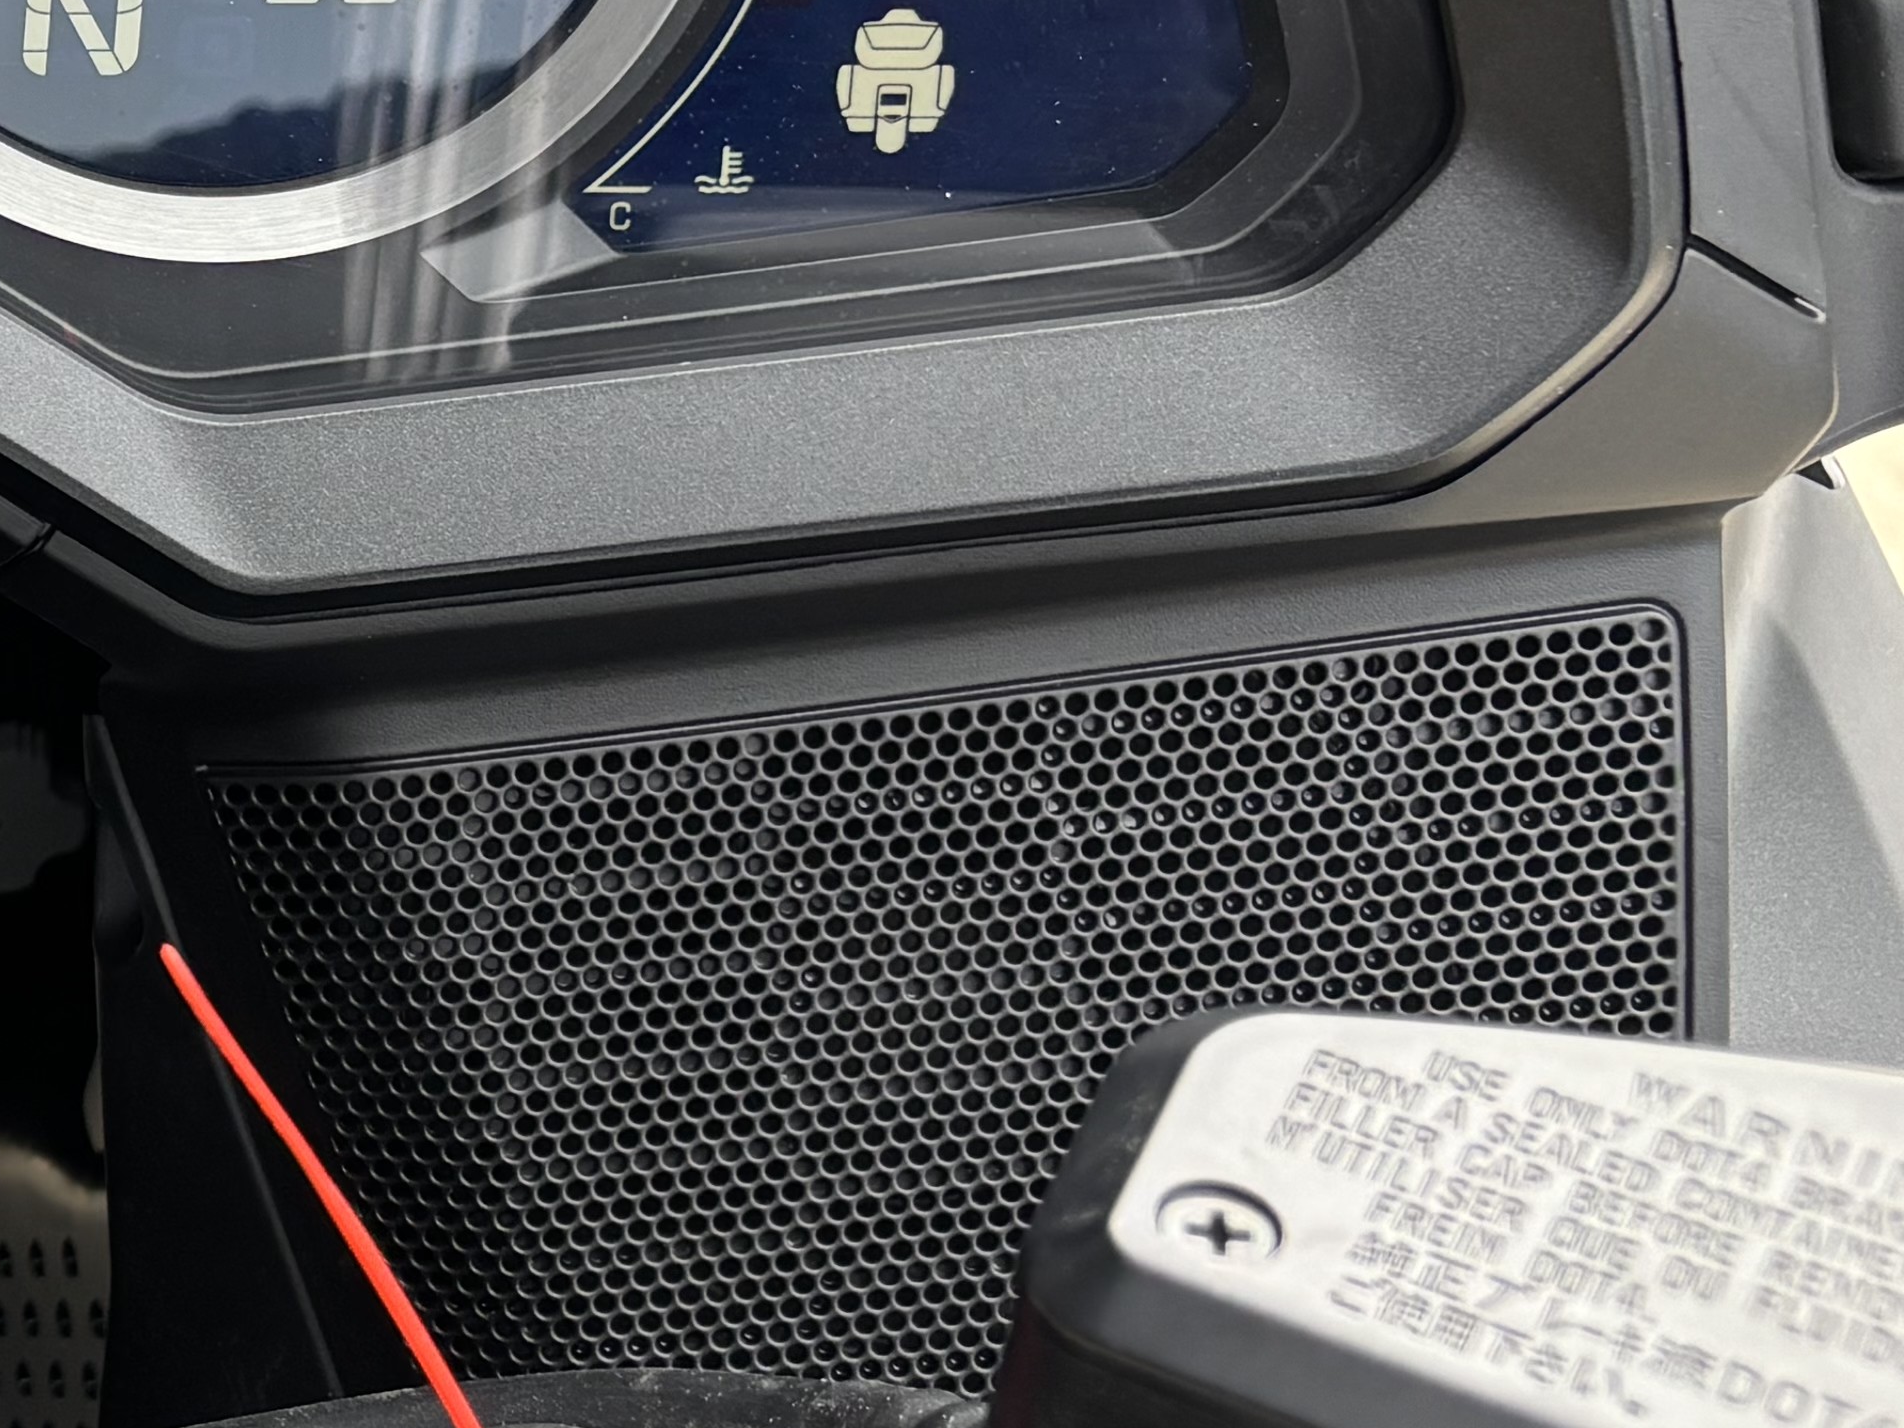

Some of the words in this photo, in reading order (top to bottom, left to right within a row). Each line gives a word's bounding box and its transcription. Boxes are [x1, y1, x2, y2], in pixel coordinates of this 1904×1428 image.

[610, 202, 631, 230] C
[1423, 1049, 1510, 1102] USE
[1284, 1082, 1441, 1161] FILLER
[1302, 1049, 1427, 1112] FROM
[1431, 1095, 1469, 1130] A
[1483, 1111, 1662, 1193] SEALED
[1670, 1175, 1904, 1283] CONTAINE
[1747, 1284, 1904, 1372] FLUID
